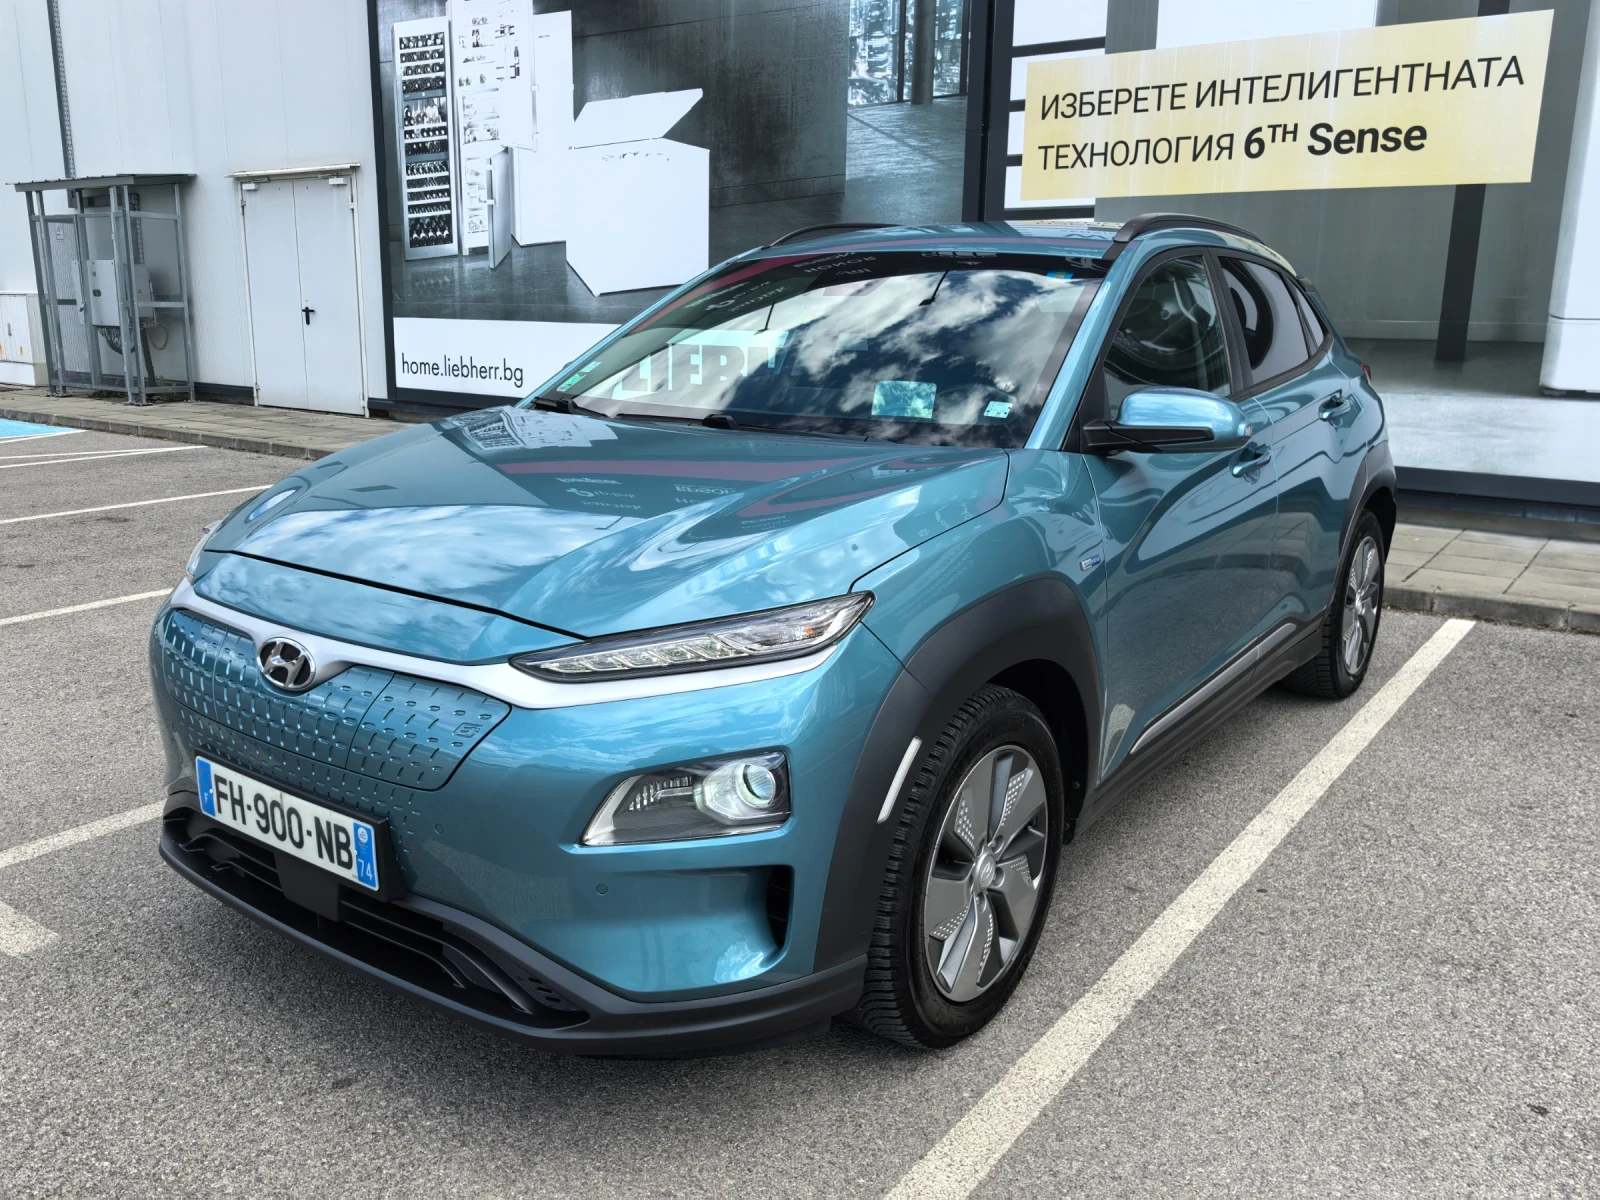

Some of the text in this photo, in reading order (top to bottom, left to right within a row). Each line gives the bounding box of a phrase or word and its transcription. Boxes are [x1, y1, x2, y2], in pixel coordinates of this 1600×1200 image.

[1041, 55, 1525, 120] ИЗБЕРЕТЕ ИНТЕЛИГЕНТНАТА
[1038, 133, 1235, 170] ТЕХНОЛОГИЯ
[1307, 122, 1428, 156] Sense
[401, 353, 524, 388] home.liebherr.bg
[357, 858, 373, 881] 74
